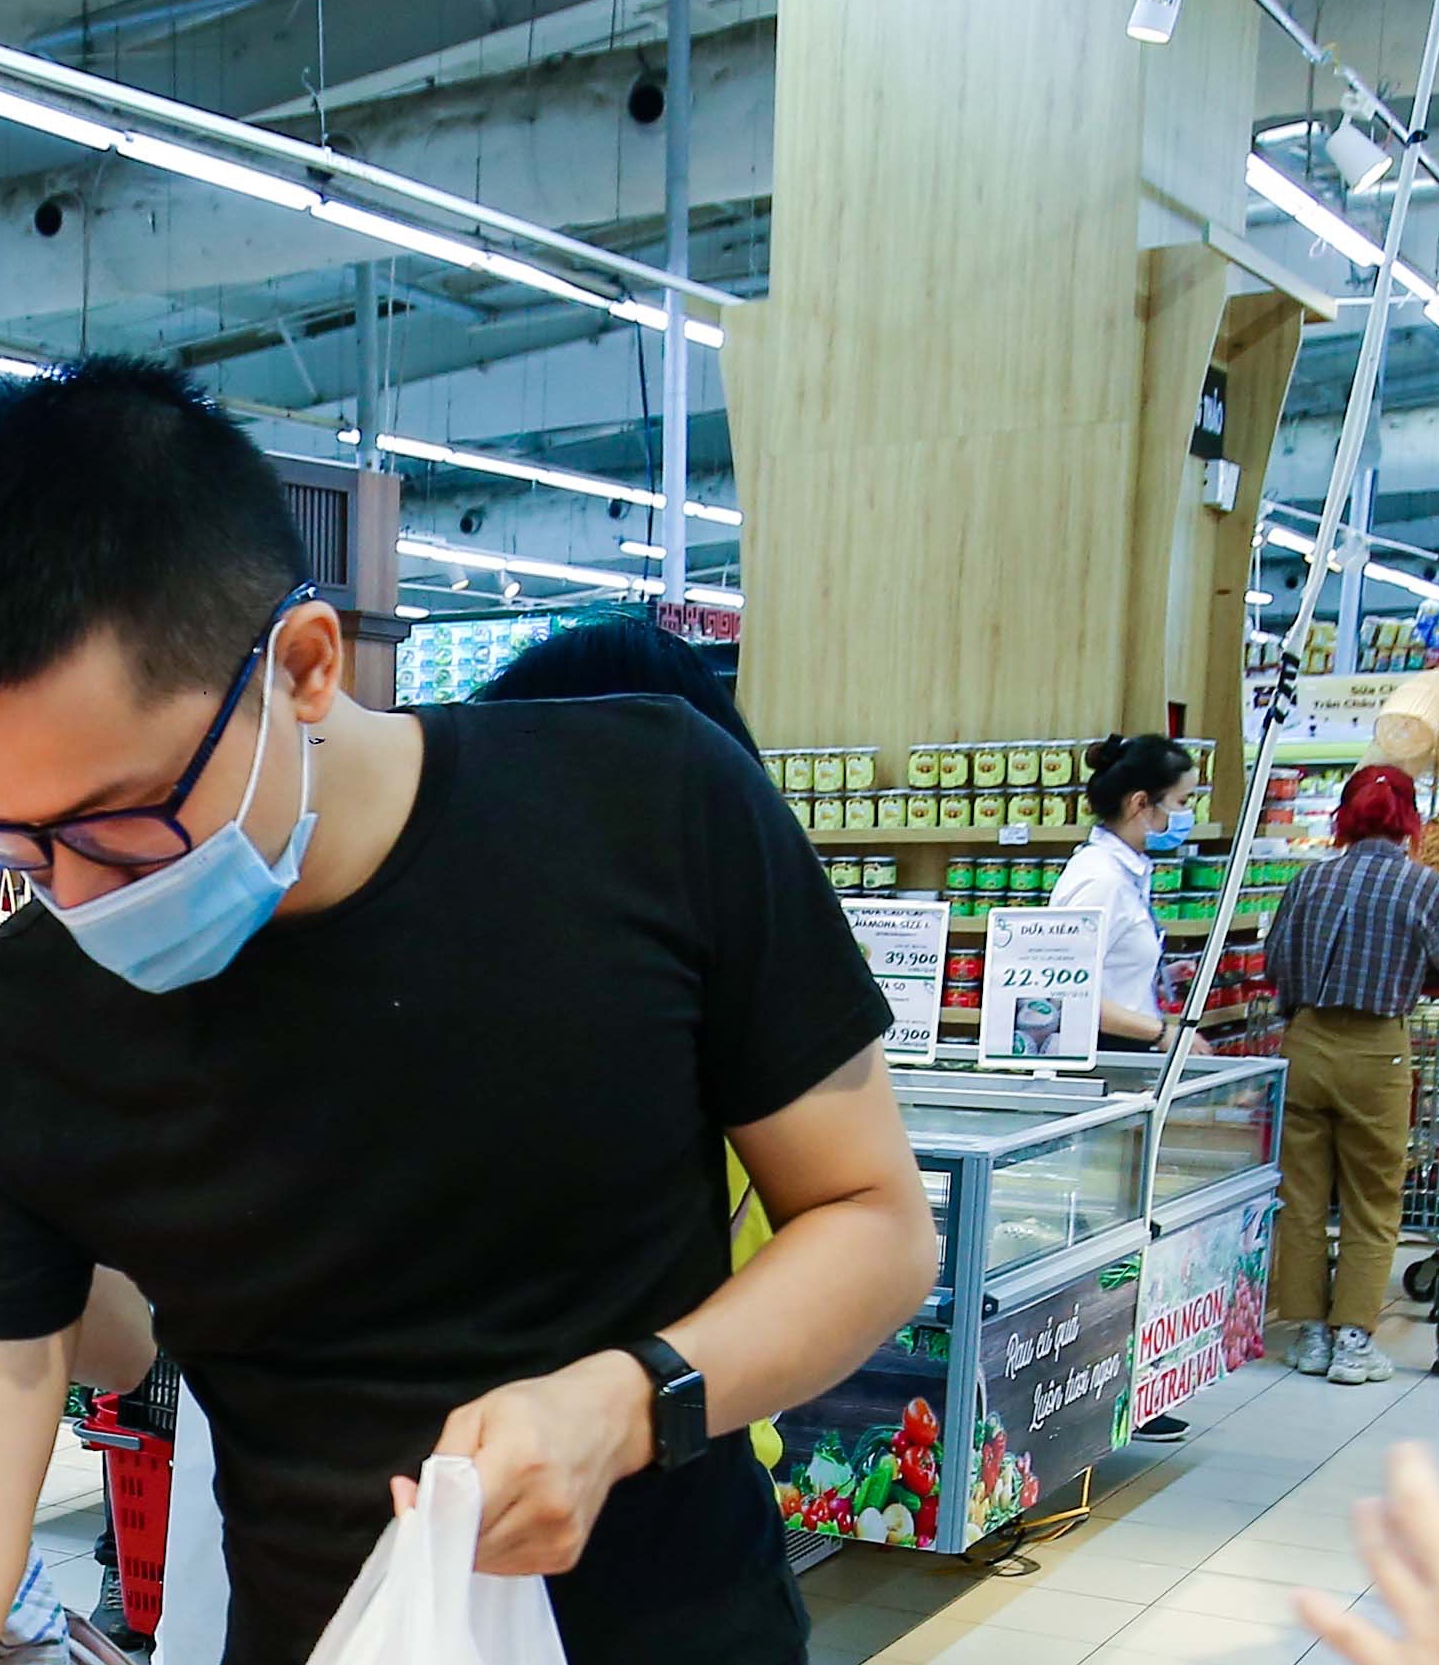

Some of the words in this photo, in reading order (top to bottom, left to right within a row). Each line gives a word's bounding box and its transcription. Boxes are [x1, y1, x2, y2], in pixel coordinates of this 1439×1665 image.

[886, 951, 938, 966] 39.900
[1003, 967, 1089, 988] 22.900
[882, 1027, 930, 1043] 9.900
[1180, 1286, 1225, 1340] NGON
[1005, 1332, 1035, 1380] Rau
[1090, 1353, 1121, 1400] ngon
